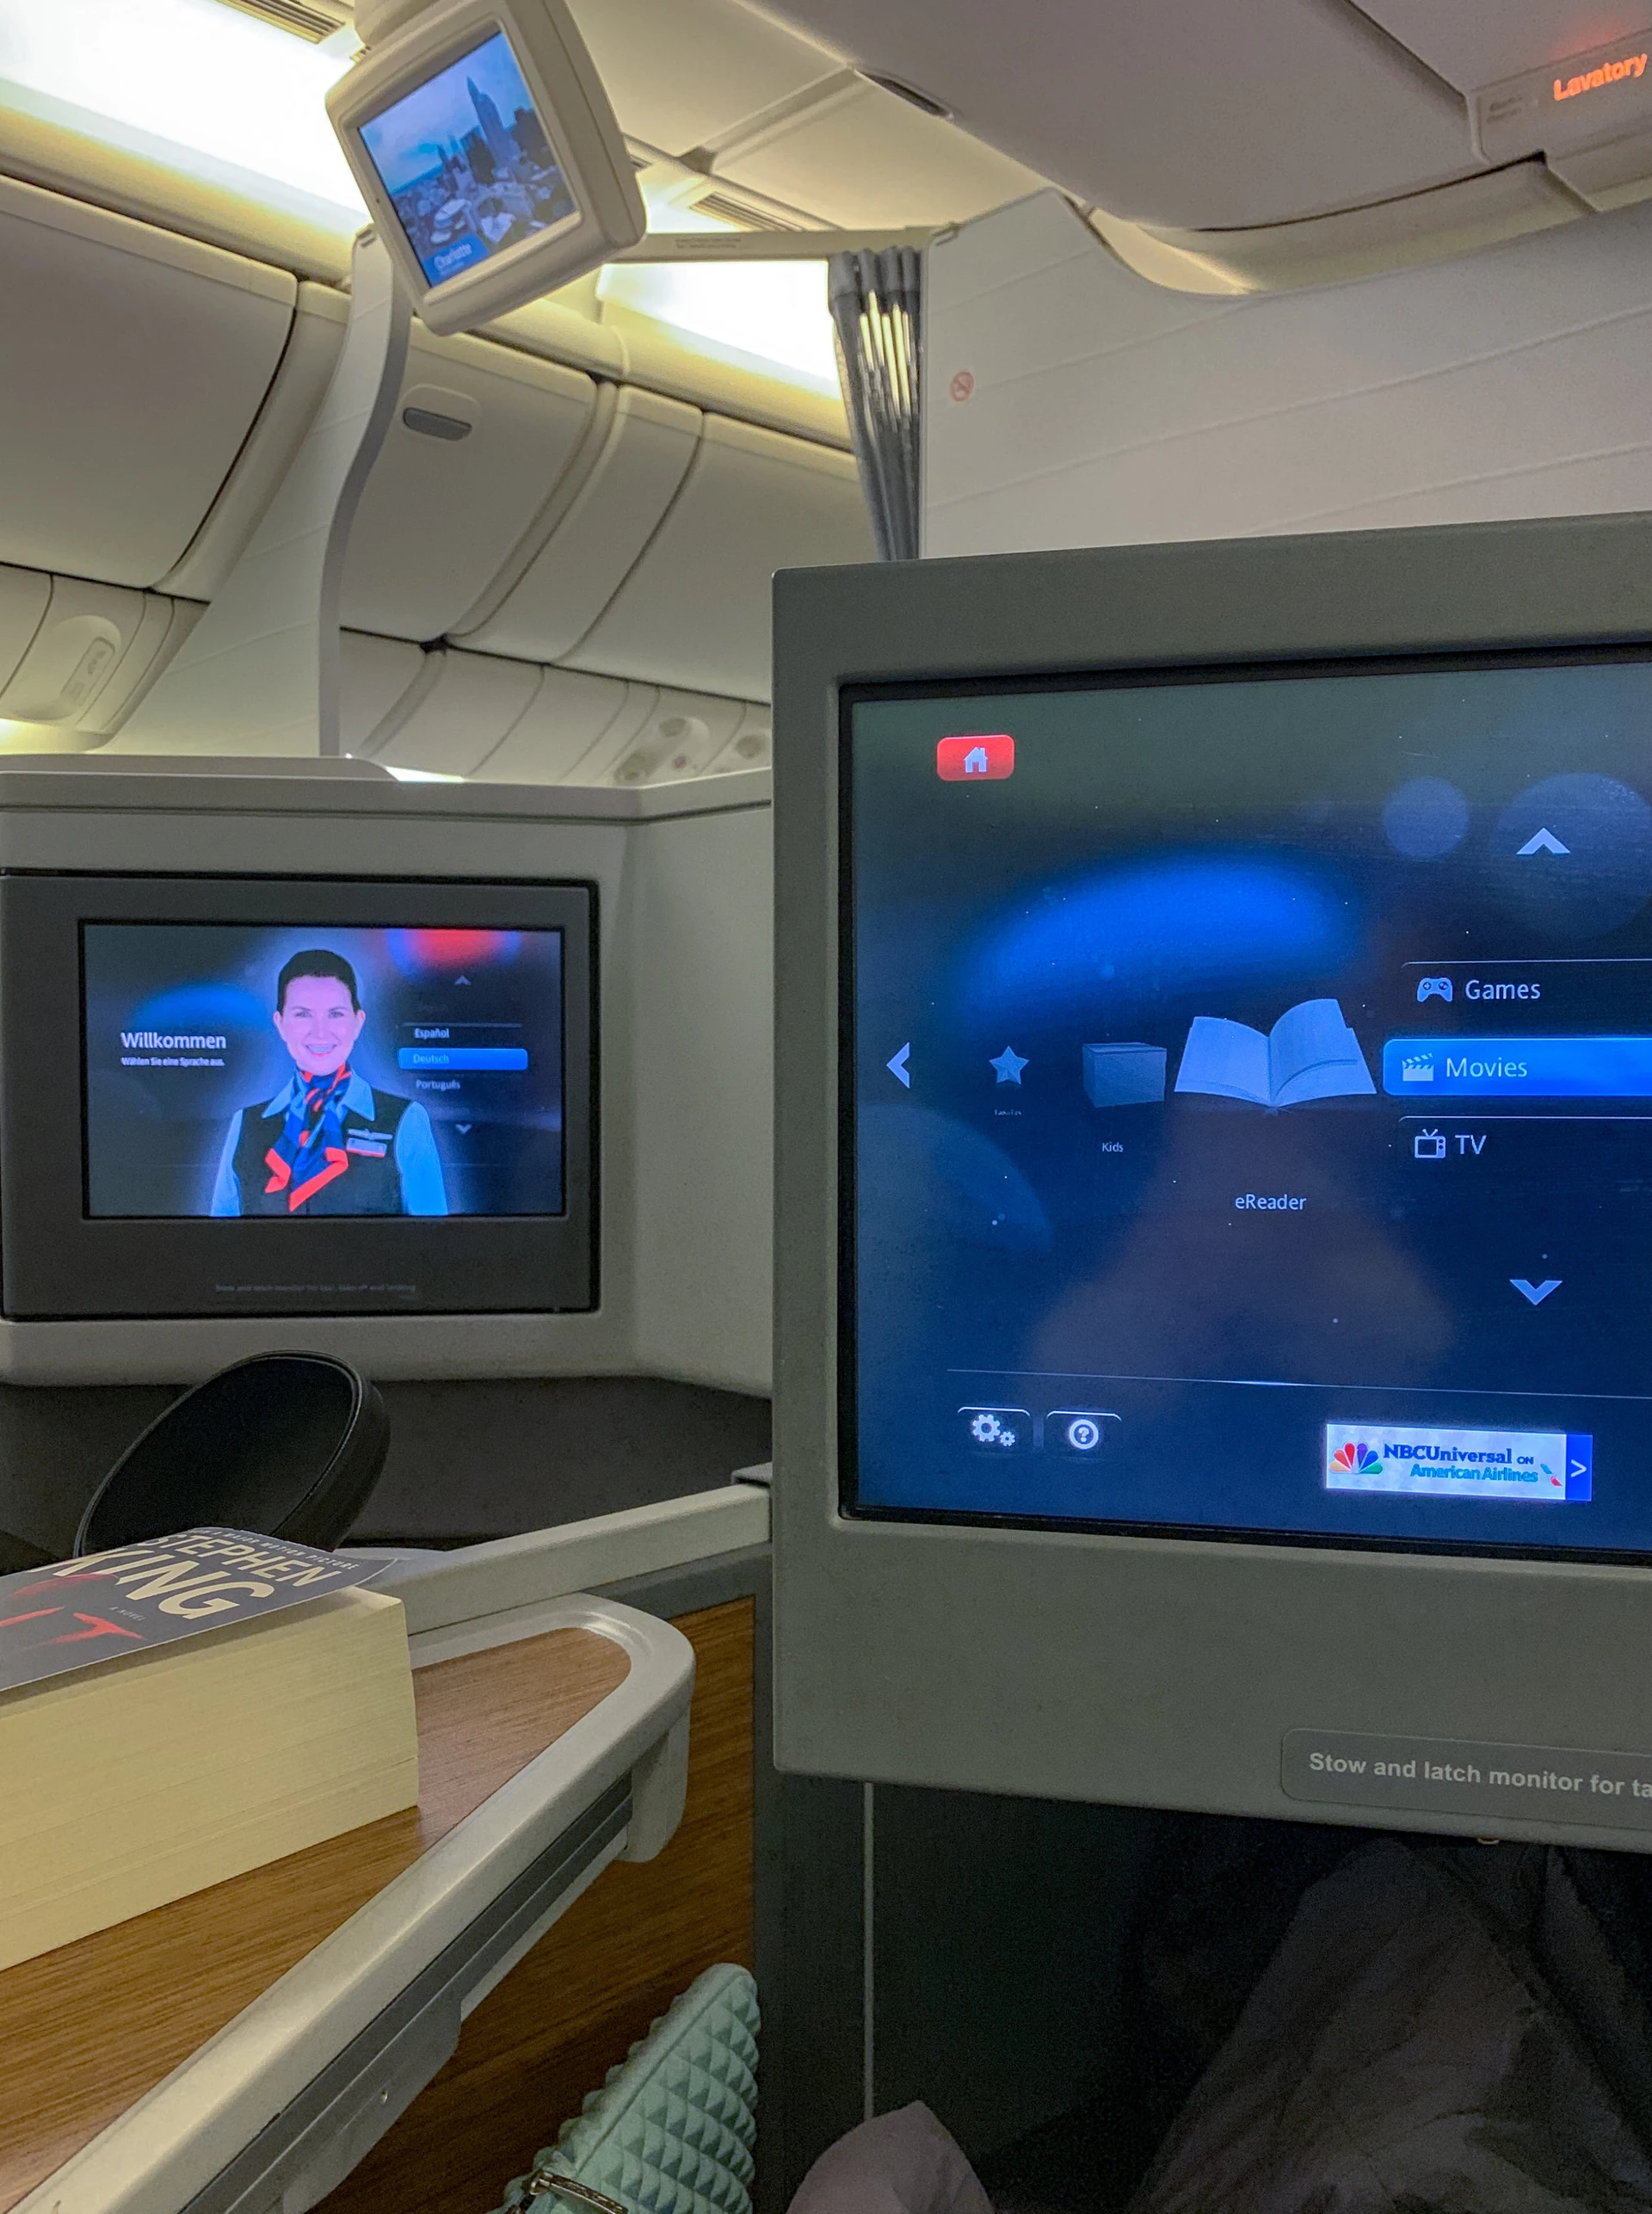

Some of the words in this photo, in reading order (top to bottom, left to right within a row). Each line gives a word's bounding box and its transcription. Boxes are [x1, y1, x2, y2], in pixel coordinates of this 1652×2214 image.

[1554, 53, 1648, 102] Lavatory
[1464, 979, 1541, 1000] Games
[120, 1032, 226, 1049] Willkommen
[414, 1027, 450, 1040] Español
[413, 1053, 450, 1064] Deutsch
[1446, 1057, 1528, 1077] Movies
[1101, 1141, 1124, 1152] Kids
[1454, 1135, 1487, 1155] TV
[1235, 1193, 1307, 1211] eReader
[1383, 1443, 1513, 1464] NBCUniversal
[1516, 1456, 1534, 1465] ON
[1409, 1464, 1482, 1479] American
[1482, 1466, 1538, 1483] Airlines
[137, 1534, 342, 1587] STEPHEN
[305, 1554, 360, 1570] PICTURE
[26, 1548, 274, 1619] KING
[1309, 1751, 1367, 1774] Stow
[1373, 1760, 1416, 1779] and
[1424, 1761, 1481, 1783] latch
[1489, 1768, 1583, 1792] monitor
[1590, 1774, 1624, 1795] for
